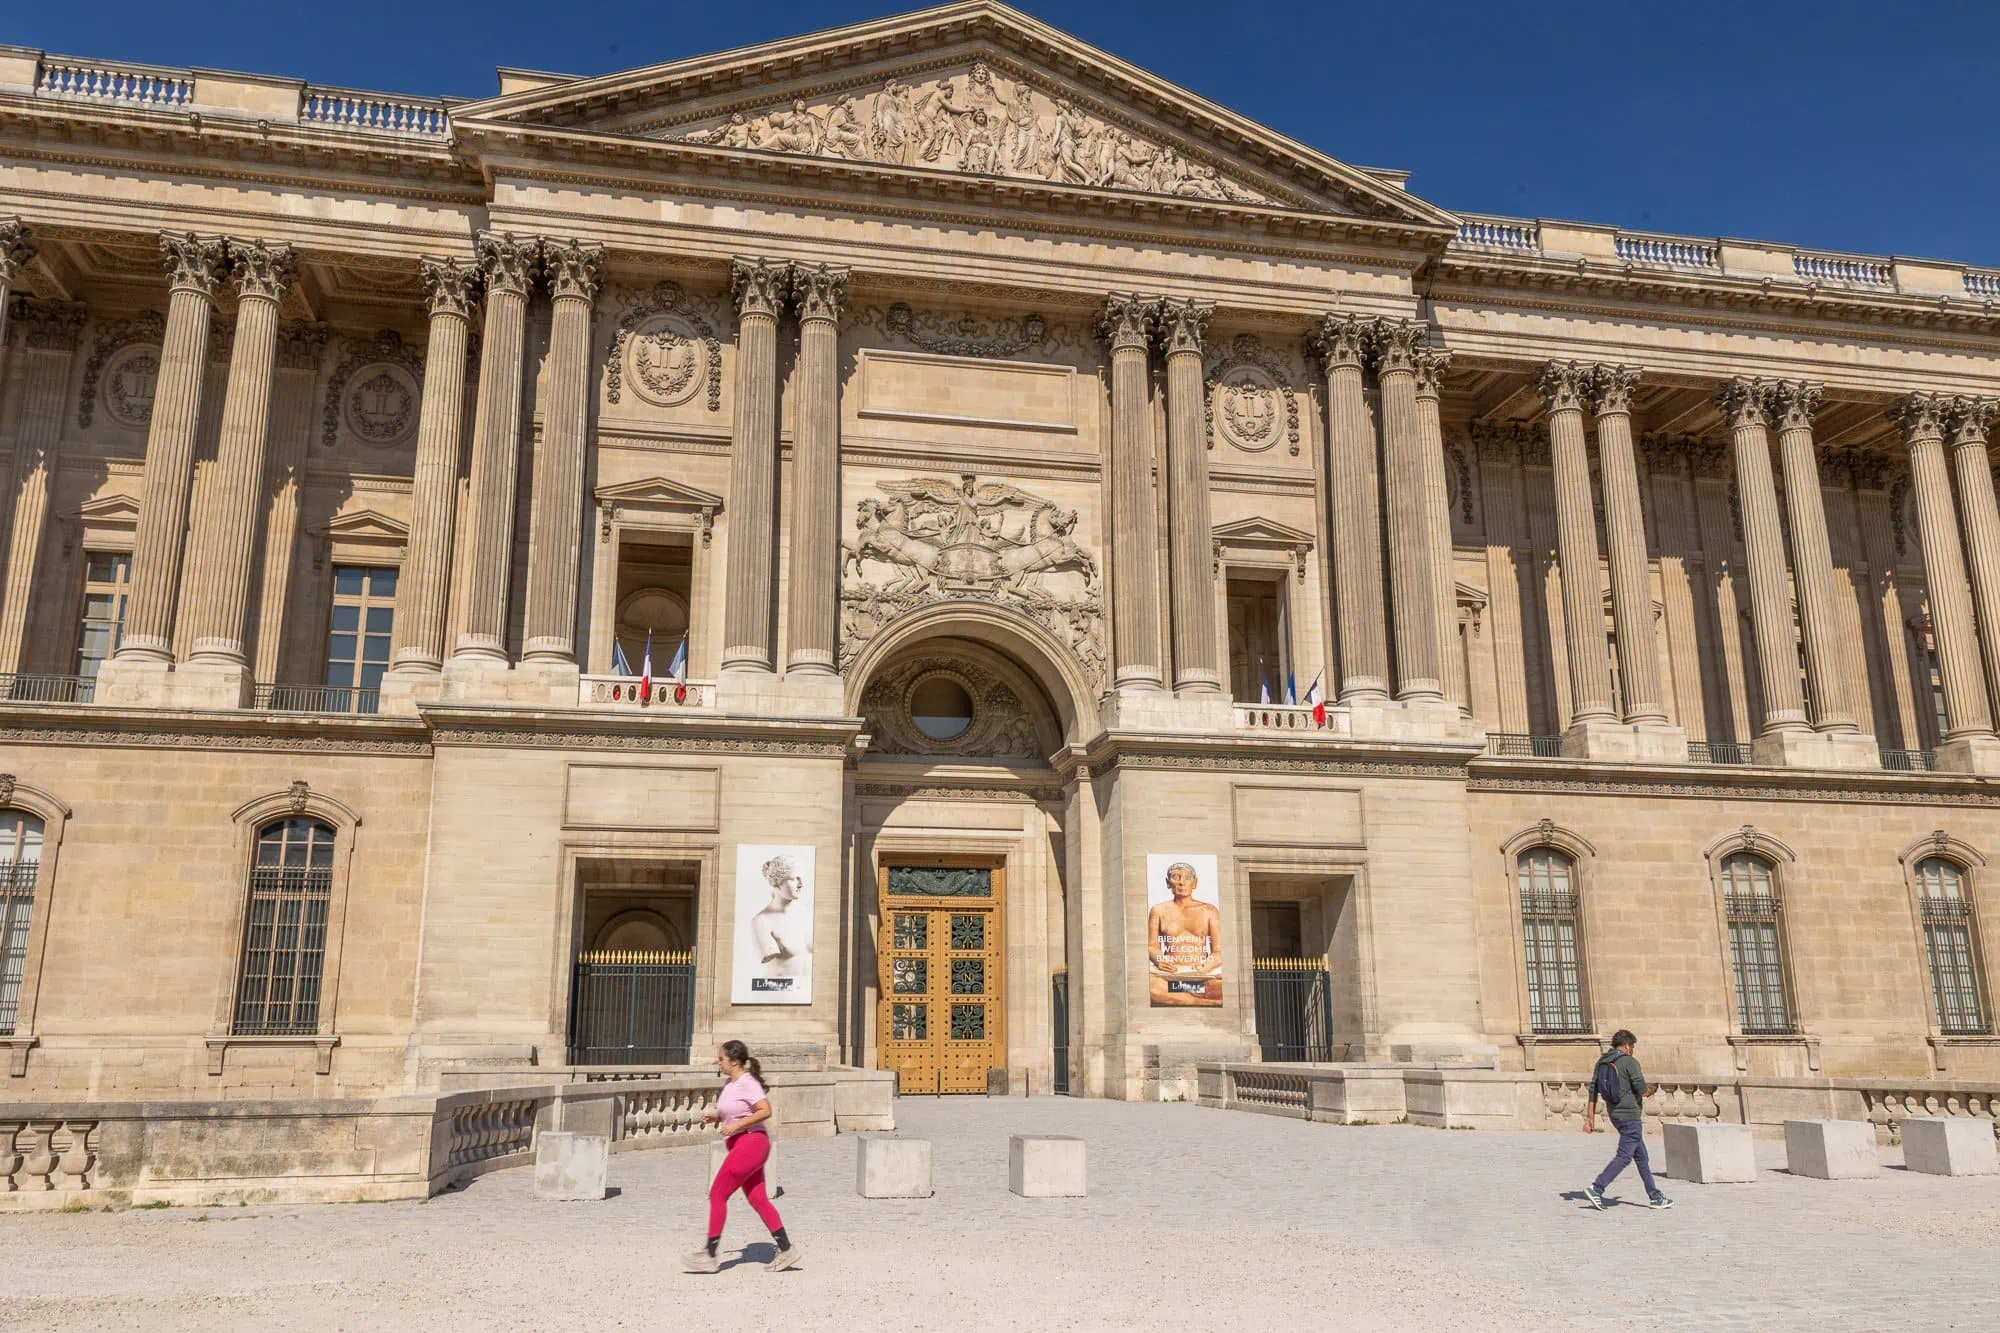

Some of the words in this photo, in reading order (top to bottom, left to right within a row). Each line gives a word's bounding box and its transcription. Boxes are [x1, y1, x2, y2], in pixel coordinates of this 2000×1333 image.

[1157, 935, 1212, 943] BIENVENUE
[1161, 945, 1209, 953] WELCOME
[1156, 954, 1215, 962] BIENVENIDO
[964, 972, 973, 982] N
